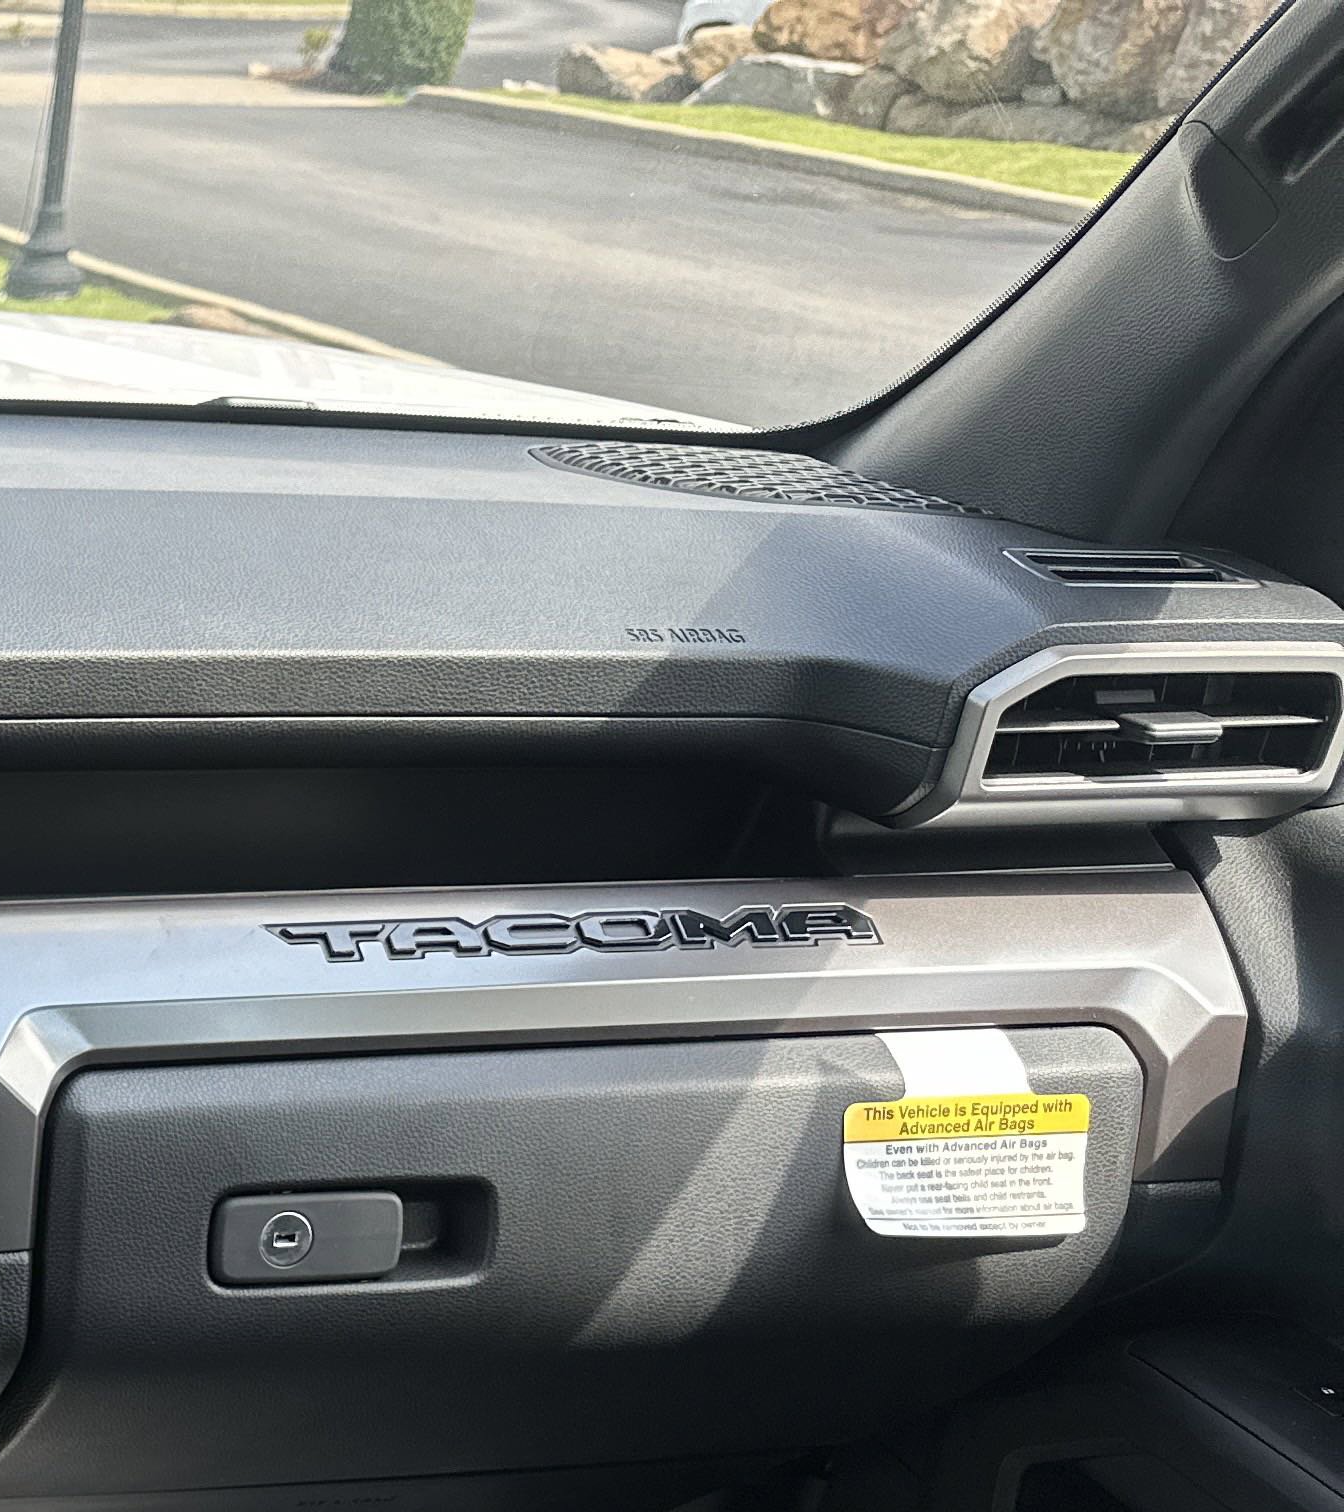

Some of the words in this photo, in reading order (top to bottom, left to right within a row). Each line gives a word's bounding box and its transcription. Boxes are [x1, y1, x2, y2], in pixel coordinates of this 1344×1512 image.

[625, 628, 663, 643] SRS
[668, 628, 746, 643] AIRBAG
[260, 903, 884, 963] TACOMA
[864, 1107, 894, 1121] This
[899, 1104, 950, 1119] Vehicle
[971, 1100, 1038, 1118] Equipped
[1043, 1099, 1072, 1113] with
[899, 1119, 970, 1136] Advanced
[974, 1118, 994, 1132] Air
[999, 1117, 1035, 1132] Bags
[886, 1144, 912, 1155] Even
[916, 1142, 939, 1153] with
[942, 1140, 997, 1152] Advanced
[1000, 1139, 1016, 1149] Air
[1019, 1138, 1048, 1150] Bags
[856, 1159, 889, 1170] Children
